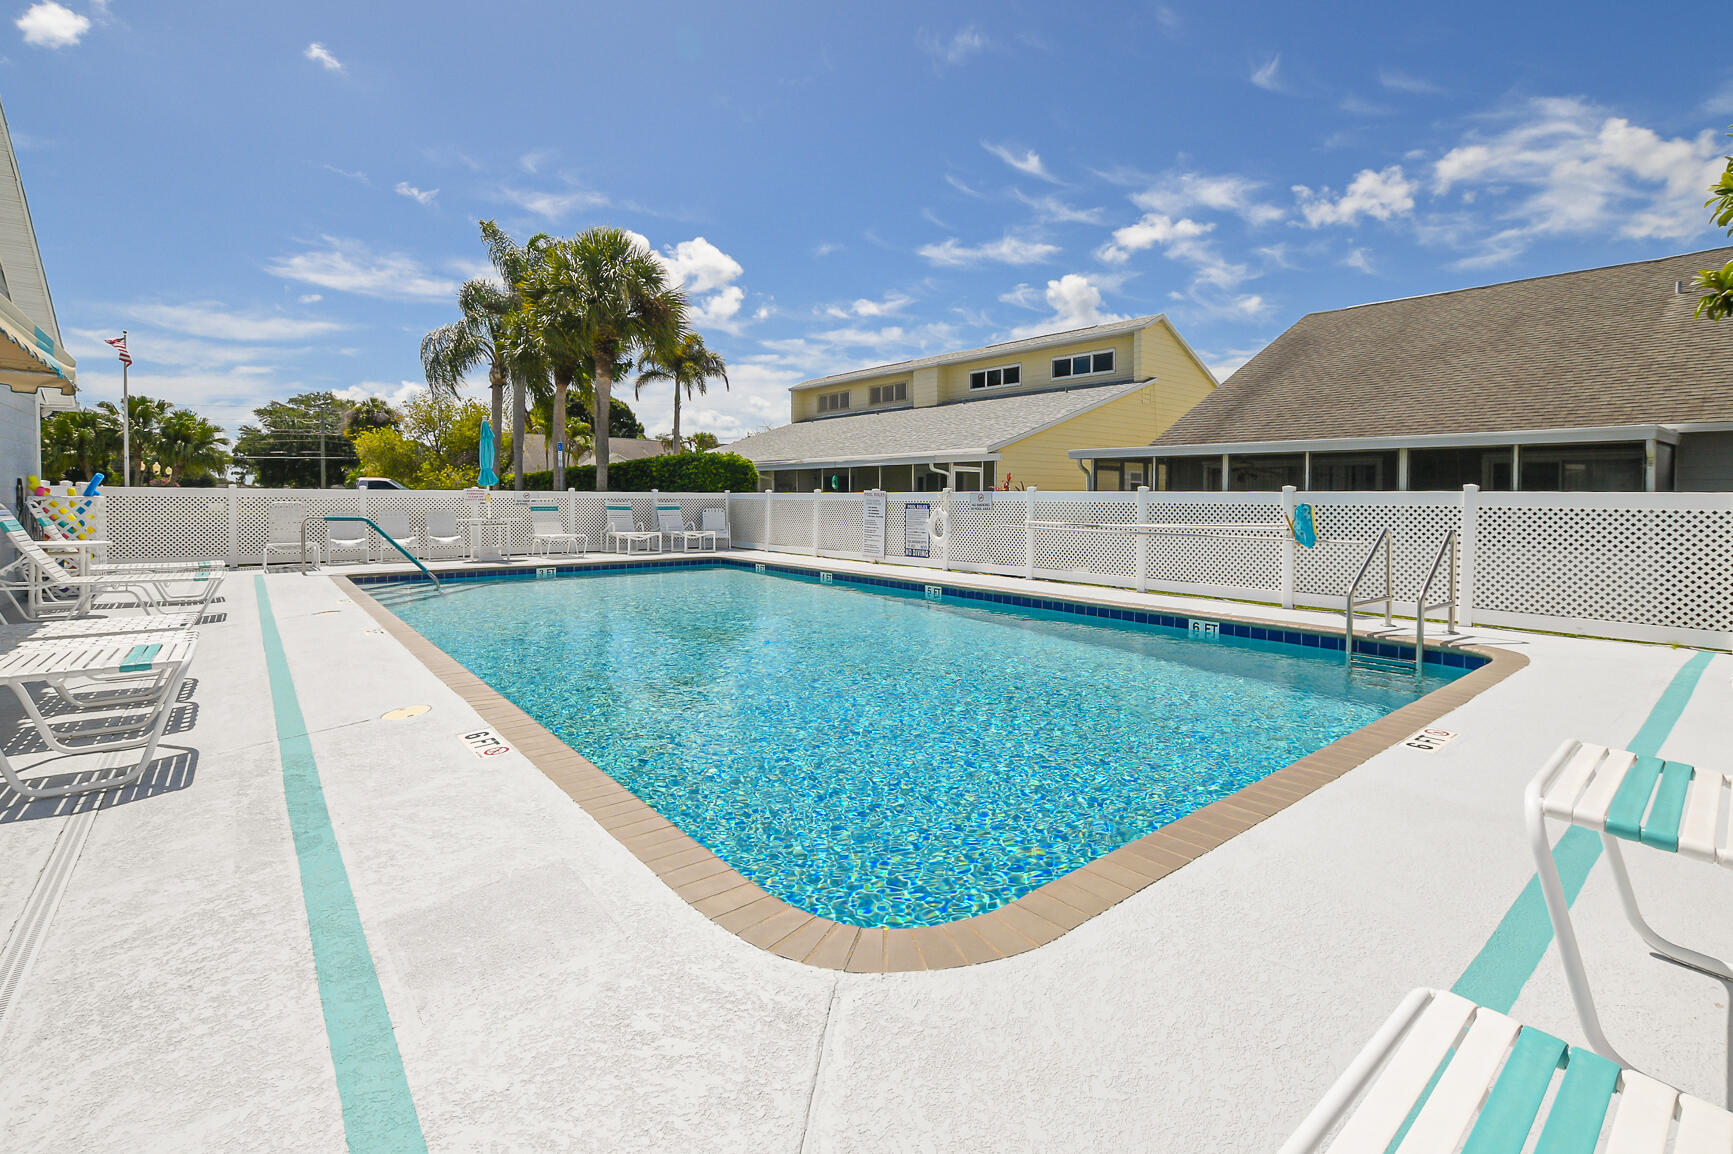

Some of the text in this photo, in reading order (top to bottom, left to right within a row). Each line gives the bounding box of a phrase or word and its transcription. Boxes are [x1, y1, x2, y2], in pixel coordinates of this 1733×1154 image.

[464, 731, 501, 749] 6 FT
[1406, 742, 1434, 750] 6
[1414, 734, 1446, 746] FT
